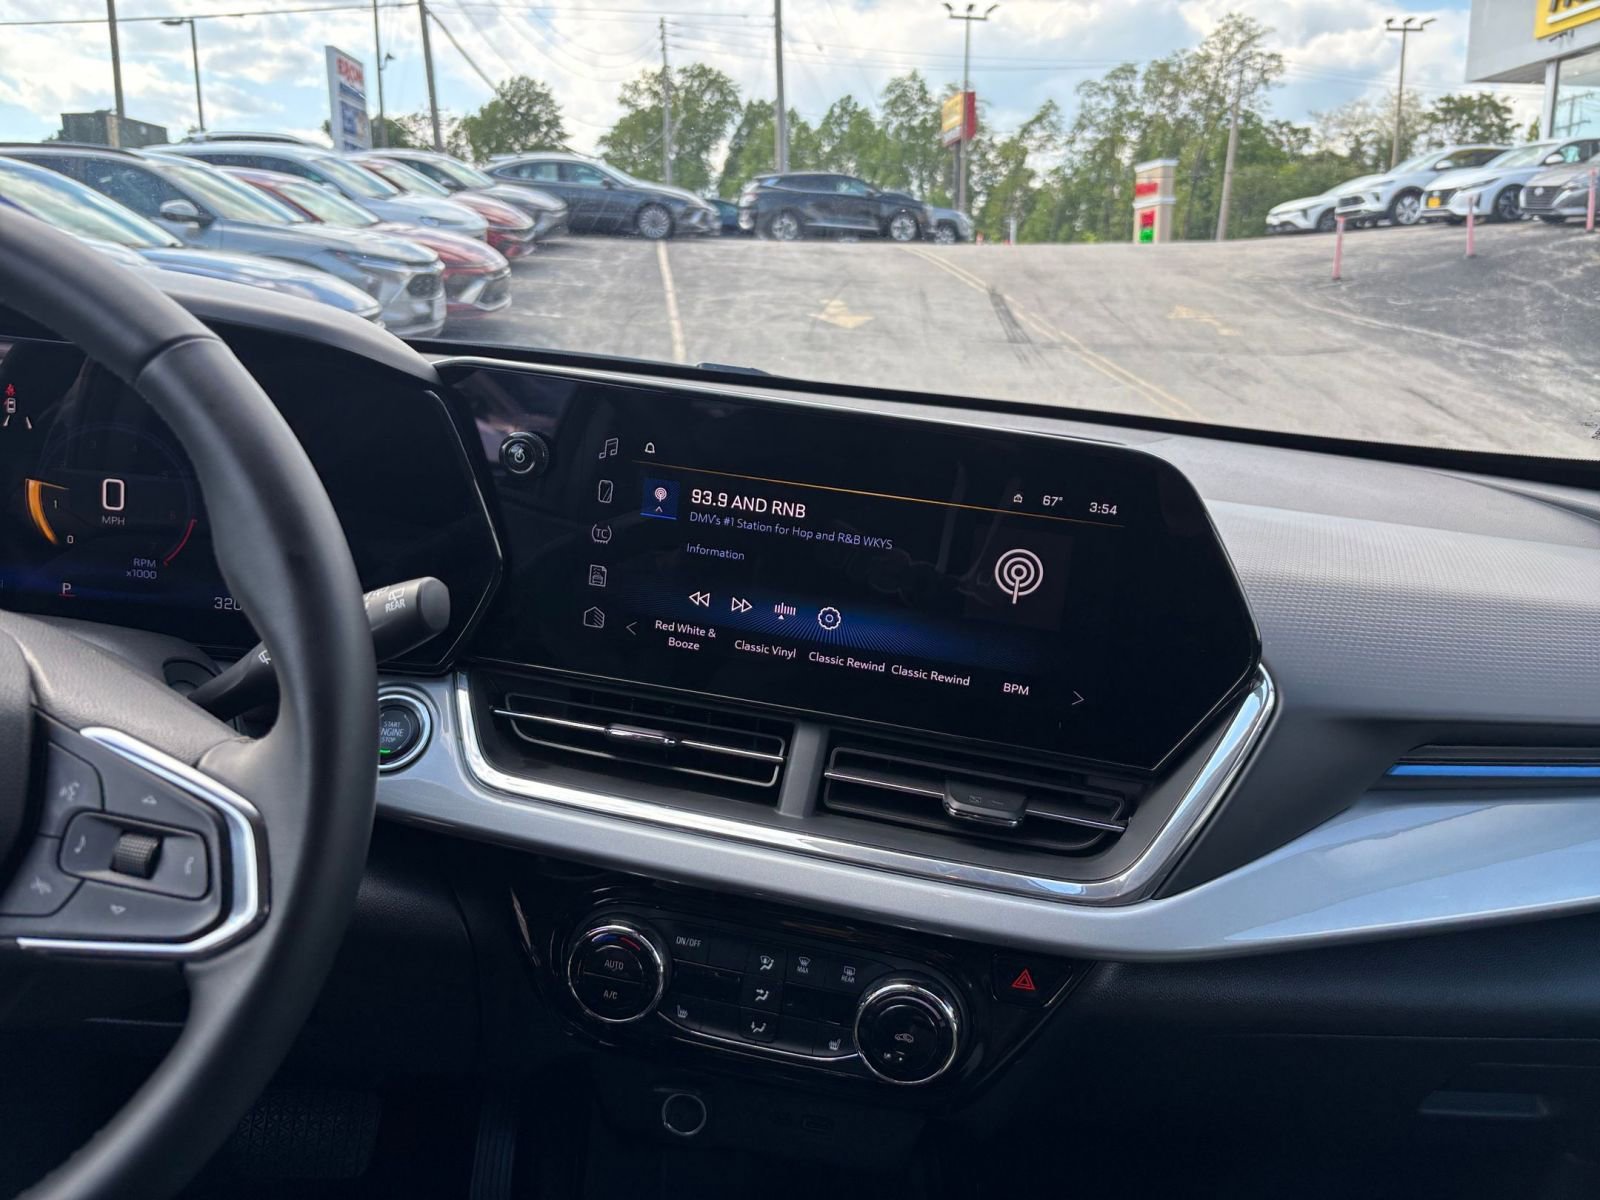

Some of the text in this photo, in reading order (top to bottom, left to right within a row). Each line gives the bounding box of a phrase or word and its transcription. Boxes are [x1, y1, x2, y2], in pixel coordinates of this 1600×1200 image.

[102, 478, 125, 511] 0
[1042, 494, 1063, 507] 67°
[691, 488, 807, 519] 93.9 AND RNB
[1089, 501, 1119, 515] 3:54
[101, 515, 126, 526] MPH
[689, 511, 894, 550] DMV's #1 Station for Hop and R&B WKYS
[66, 534, 74, 544] 0
[686, 543, 745, 560] Information
[133, 557, 156, 568] RPM
[126, 568, 157, 580] x1000
[62, 582, 72, 594] P
[384, 599, 406, 613] REAR
[655, 619, 717, 638] Red White &
[668, 637, 701, 650] Booze
[734, 639, 797, 660] Classic Vinyl
[808, 651, 886, 673] Classic Rewind
[891, 664, 971, 686] Classic Rewind
[1003, 682, 1030, 696] BPM
[380, 727, 405, 737] NGINE
[675, 936, 702, 948] ON/OFF
[604, 958, 624, 971] AUTO
[603, 989, 618, 1000] A/C
